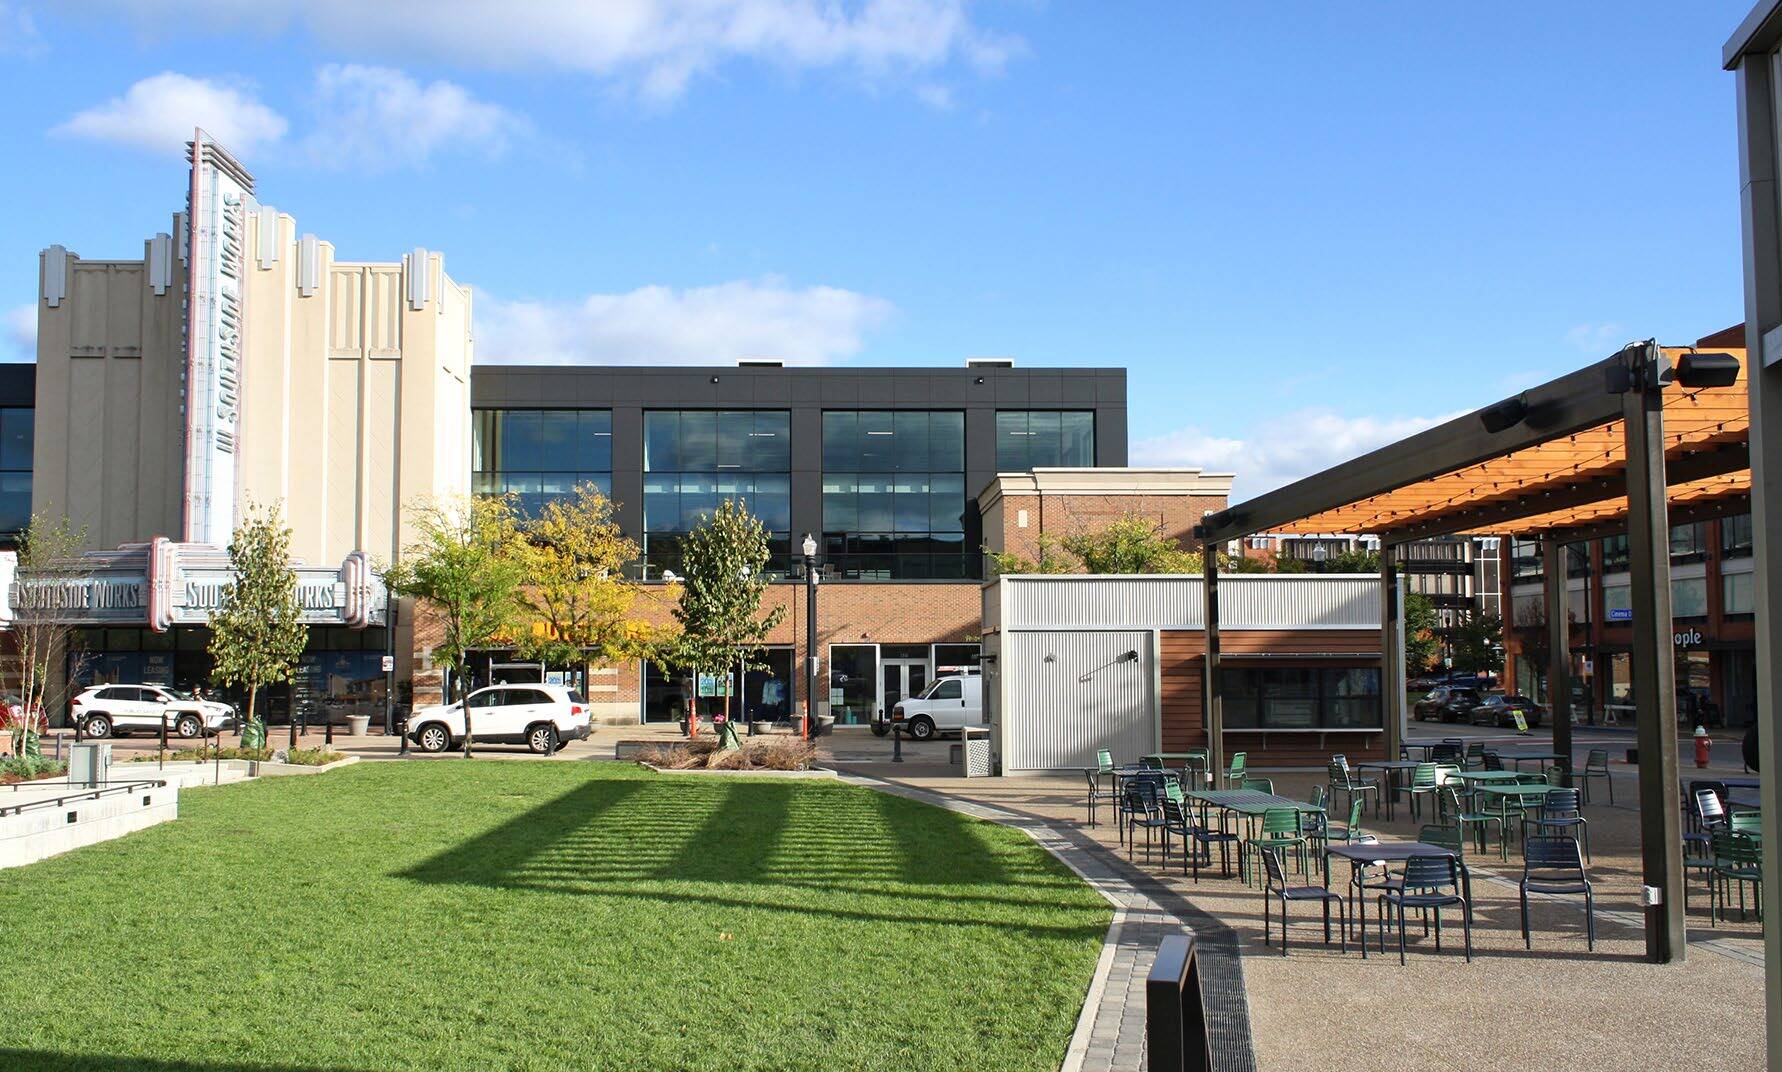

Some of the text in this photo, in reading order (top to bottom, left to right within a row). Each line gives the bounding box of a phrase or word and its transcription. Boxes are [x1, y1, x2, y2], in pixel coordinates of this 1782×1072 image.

[216, 192, 240, 424] SOUTHSIDE WORKS
[93, 580, 139, 609] WORKS
[294, 585, 334, 609] ORKS
[1674, 627, 1702, 648] ople
